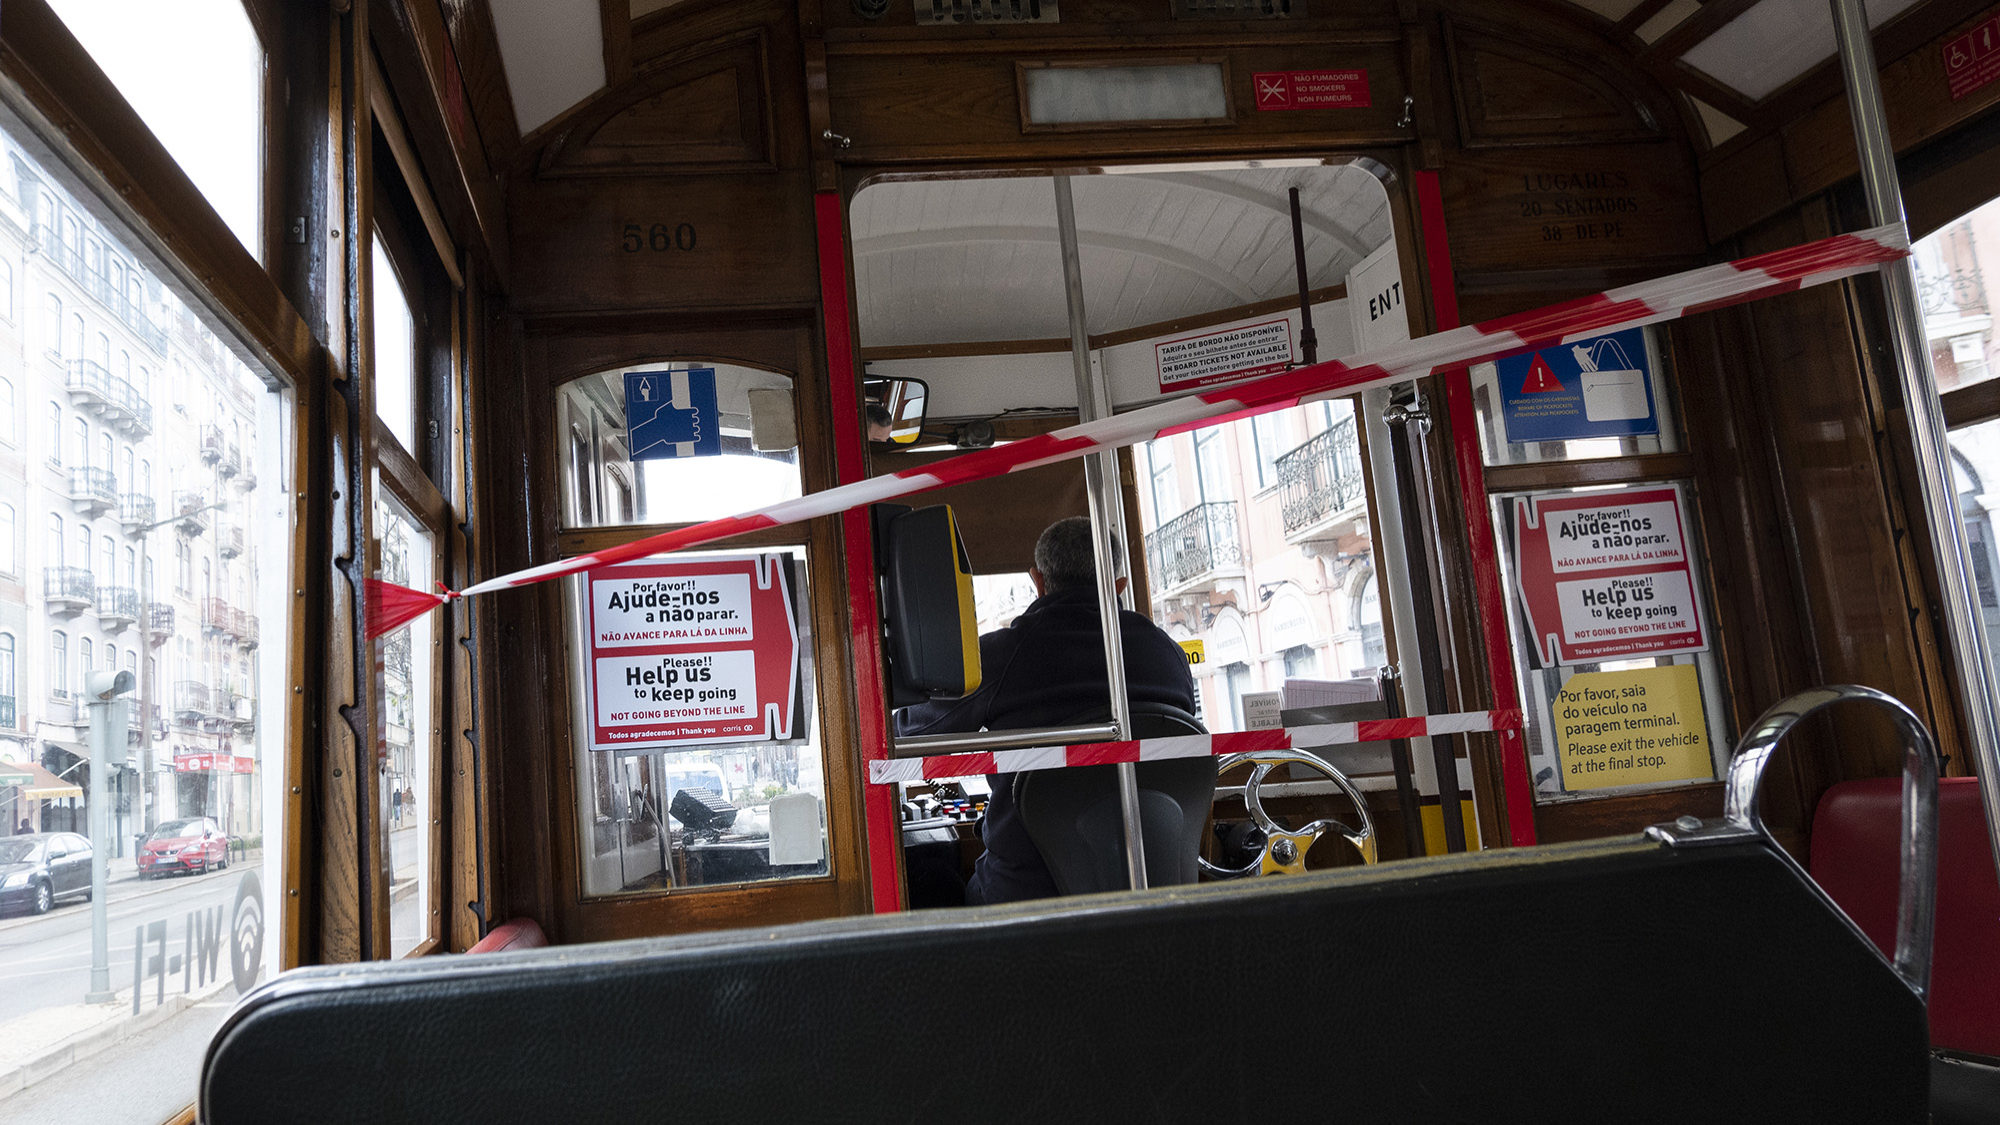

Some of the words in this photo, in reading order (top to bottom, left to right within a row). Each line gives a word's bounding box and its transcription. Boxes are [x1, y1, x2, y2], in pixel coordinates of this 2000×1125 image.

[1312, 73, 1359, 81] FUMADORES
[1524, 171, 1629, 192] LUGARES
[1521, 200, 1542, 217] 20
[1555, 196, 1638, 216] SENTADOS
[623, 222, 696, 253] 560
[1542, 225, 1562, 241] 38
[1576, 224, 1598, 240] DE
[1369, 282, 1400, 321] ENT
[1162, 344, 1186, 355] TARIFA
[1199, 337, 1223, 347] BORDO
[1224, 333, 1240, 343] NÃO
[1241, 325, 1284, 339] DISPONÍVEL
[1163, 353, 1187, 363] Adquira
[1206, 345, 1228, 355] bilhete
[1229, 342, 1247, 350] antes
[1258, 335, 1278, 344] entrar
[1174, 360, 1198, 371] BOARD
[1200, 355, 1229, 366] TICKETS
[1231, 351, 1245, 360] NOT
[1247, 344, 1287, 357] AVAILABLE
[1175, 372, 1189, 380] your
[1191, 367, 1208, 376] ticket
[1210, 364, 1230, 373] before
[1232, 360, 1254, 370] getting
[1578, 513, 1595, 522] Por
[1598, 509, 1630, 521] favor!!
[1559, 517, 1652, 541] Ajude-nos
[1592, 539, 1600, 548] a
[1603, 532, 1632, 548] não
[1635, 534, 1669, 547] parar.
[1558, 559, 1574, 567] NÃO
[1576, 556, 1607, 566] AVANCE
[1609, 554, 1629, 562] PARA
[1631, 552, 1642, 560] LÁ
[1643, 551, 1653, 559] DA
[1655, 549, 1679, 558] LINHA
[633, 583, 653, 592] Por
[657, 580, 696, 591] favor!!
[1612, 578, 1653, 589] Please!!
[608, 590, 720, 613] Ajude-nos
[1582, 588, 1627, 608] Help
[1632, 588, 1654, 600] us
[646, 612, 654, 623] a
[660, 604, 694, 622] não
[697, 609, 739, 622] parar.
[1592, 608, 1602, 618] to
[1606, 606, 1642, 620] keep
[1646, 605, 1677, 618] going
[602, 633, 621, 642] NÃO
[624, 631, 660, 640] AVANCE
[663, 628, 688, 638] PARA
[690, 626, 702, 637] LÁ
[705, 628, 717, 636] DA
[720, 627, 747, 635] LINHA
[1575, 631, 1590, 639] NOT
[1592, 627, 1617, 637] GOING
[1619, 625, 1649, 634] BEYOND
[1652, 623, 1667, 632] THE
[1669, 621, 1686, 629] LINE
[1593, 644, 1630, 654] agradecemos
[663, 657, 712, 669] Please!!
[626, 666, 678, 688] Help
[685, 667, 711, 682] us
[634, 689, 646, 699] to
[652, 687, 694, 703] keep
[699, 688, 736, 702] going
[1560, 690, 1581, 703] Por
[1584, 688, 1619, 700] favor,
[1622, 684, 1646, 698] saia
[611, 712, 629, 721] NOT
[632, 710, 661, 719] GOING
[663, 709, 701, 718] BEYOND
[704, 707, 721, 716] THE
[724, 706, 745, 715] LINE
[1563, 706, 1579, 719] do
[1582, 702, 1628, 717] veículo
[1632, 702, 1647, 712] na
[630, 729, 676, 739] agradecemos
[681, 727, 702, 735] Thank
[1566, 720, 1621, 738] paragem
[1624, 713, 1680, 730] terminal.
[1568, 743, 1607, 756] Please
[1610, 739, 1632, 752] exit
[1635, 737, 1654, 749] the
[1658, 732, 1699, 747] vehicle
[1571, 761, 1582, 774] at
[1586, 759, 1606, 772] the
[1609, 755, 1634, 770] final
[1637, 755, 1666, 769] stop.
